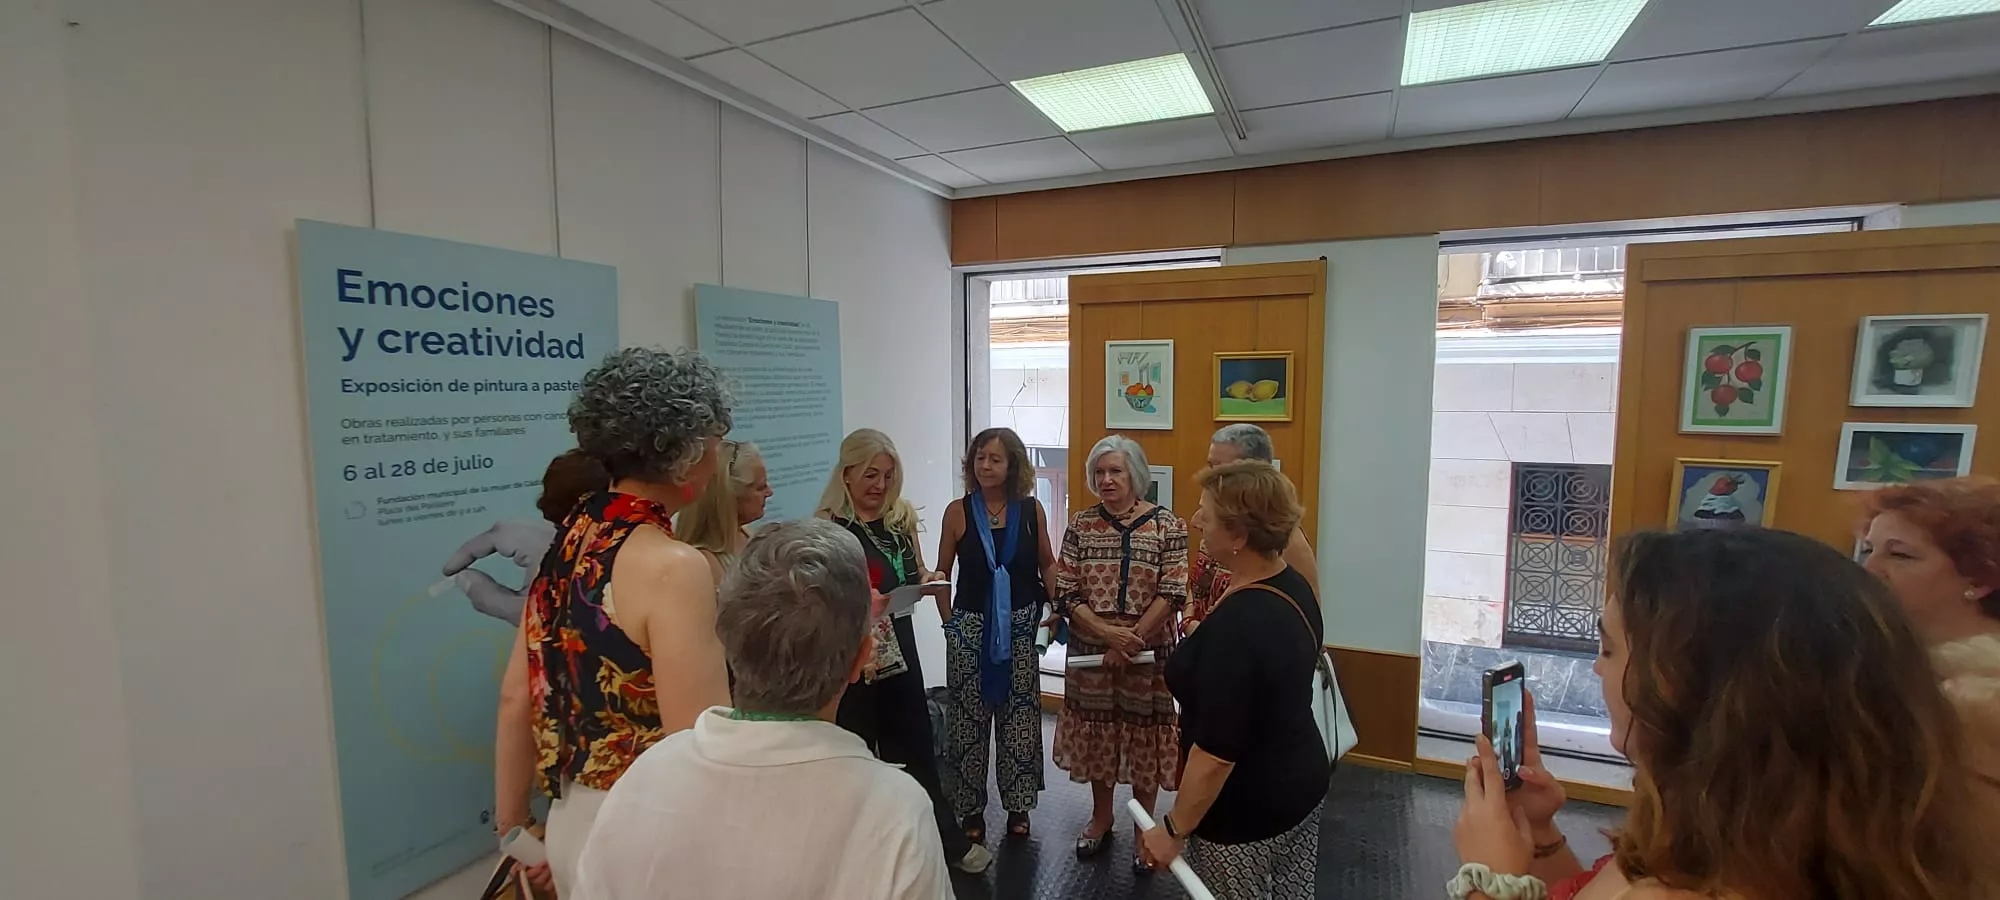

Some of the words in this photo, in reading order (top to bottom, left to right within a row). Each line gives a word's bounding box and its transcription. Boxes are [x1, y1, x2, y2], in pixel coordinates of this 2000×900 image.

[336, 267, 555, 318] Emociones
[337, 326, 364, 361] y
[377, 326, 585, 359] creatividad
[341, 378, 443, 396] Exposición
[448, 379, 469, 392] de
[473, 379, 528, 395] pintura
[531, 382, 539, 391] a
[544, 380, 581, 395] paste
[341, 418, 382, 429] Obras
[386, 414, 448, 427] realizadas
[452, 415, 470, 426] por
[473, 413, 522, 425] personas
[524, 413, 542, 421] con
[342, 436, 360, 445] en
[443, 431, 449, 441] y
[453, 429, 472, 438] sus
[475, 426, 526, 437] familiares
[343, 464, 357, 481] 6
[364, 462, 385, 480] al
[391, 460, 416, 477] 28
[423, 457, 448, 474] de
[452, 454, 494, 475] julio
